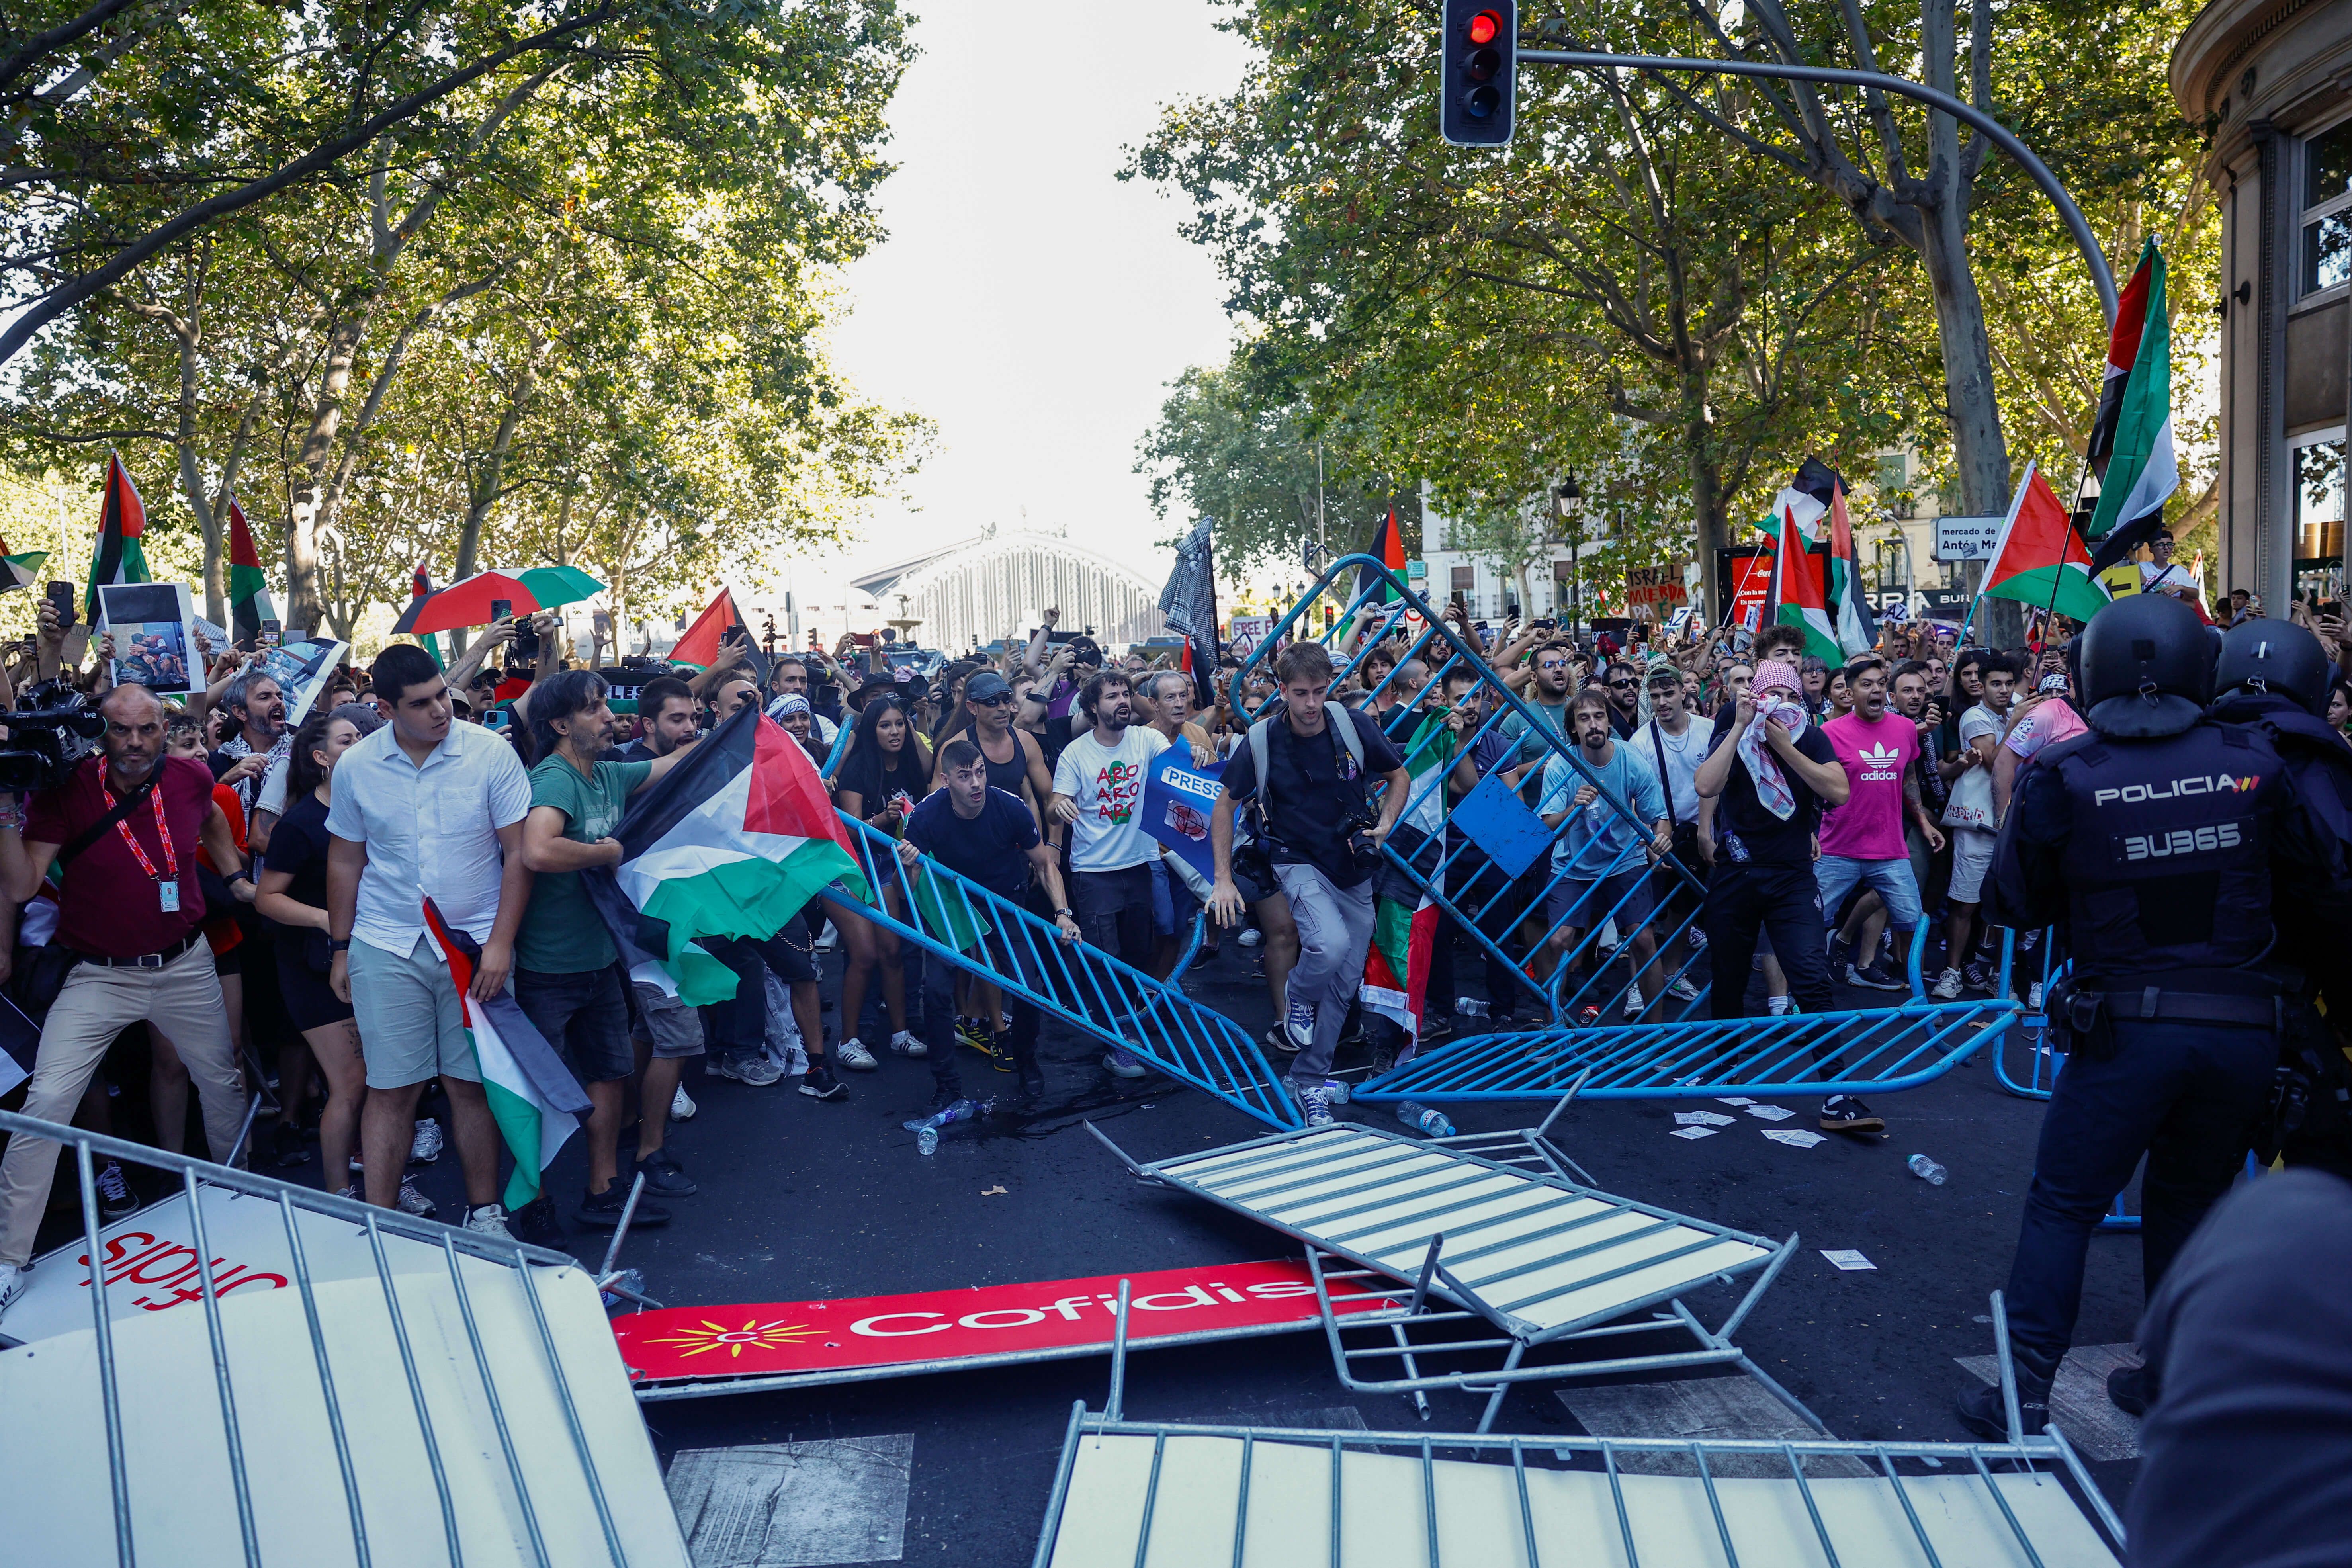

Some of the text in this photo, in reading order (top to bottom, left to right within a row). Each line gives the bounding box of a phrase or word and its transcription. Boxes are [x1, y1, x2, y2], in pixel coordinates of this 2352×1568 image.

[1942, 540, 1974, 550] Antó
[1628, 583, 1687, 605] MIERDA
[1631, 604, 1655, 620] PA
[1234, 621, 1261, 636] FREE
[1096, 764, 1139, 786] ARO
[1169, 770, 1224, 798] PRESS
[1861, 770, 1898, 781] adidas
[1096, 782, 1139, 804] ARO
[2094, 774, 2239, 806] POLICIA
[850, 1281, 1318, 1337] Cofidis
